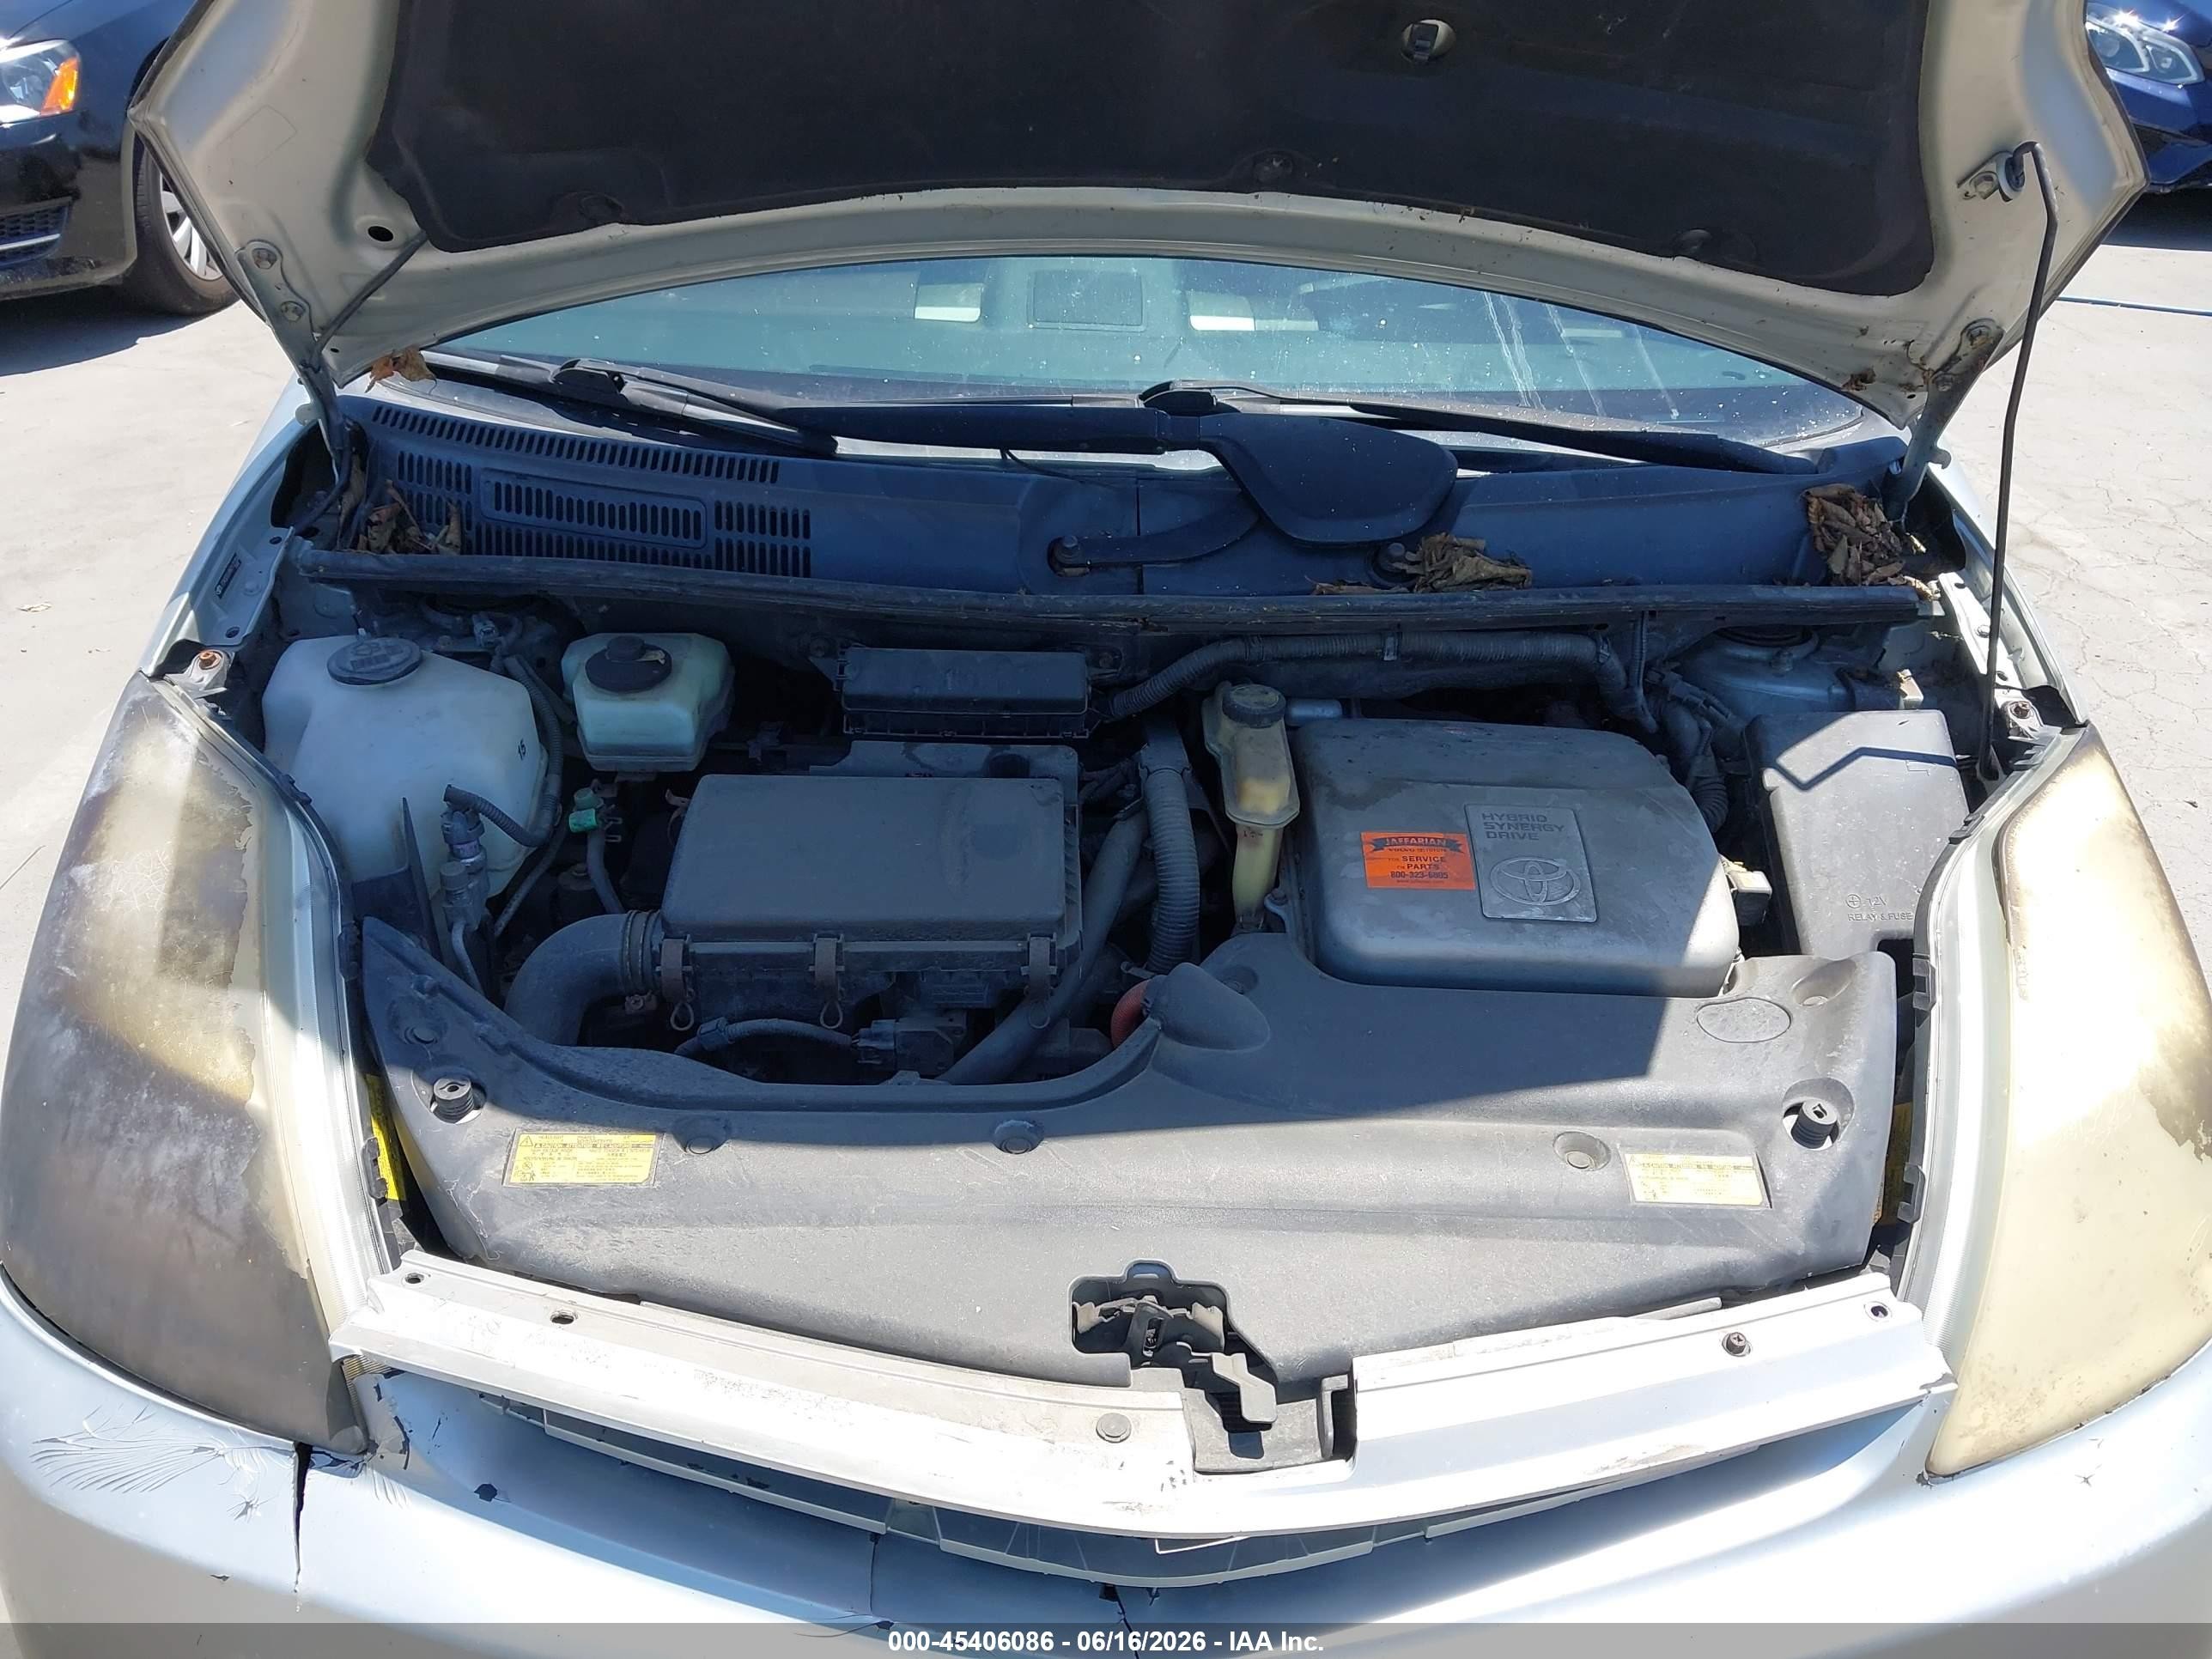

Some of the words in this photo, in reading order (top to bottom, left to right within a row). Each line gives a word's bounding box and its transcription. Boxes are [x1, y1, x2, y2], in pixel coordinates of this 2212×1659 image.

[1481, 812, 1547, 823] HYBRID
[1483, 822, 1565, 832] SYNERGY
[1486, 830, 1540, 841] DRIVE
[1887, 912, 1914, 921] FUSE
